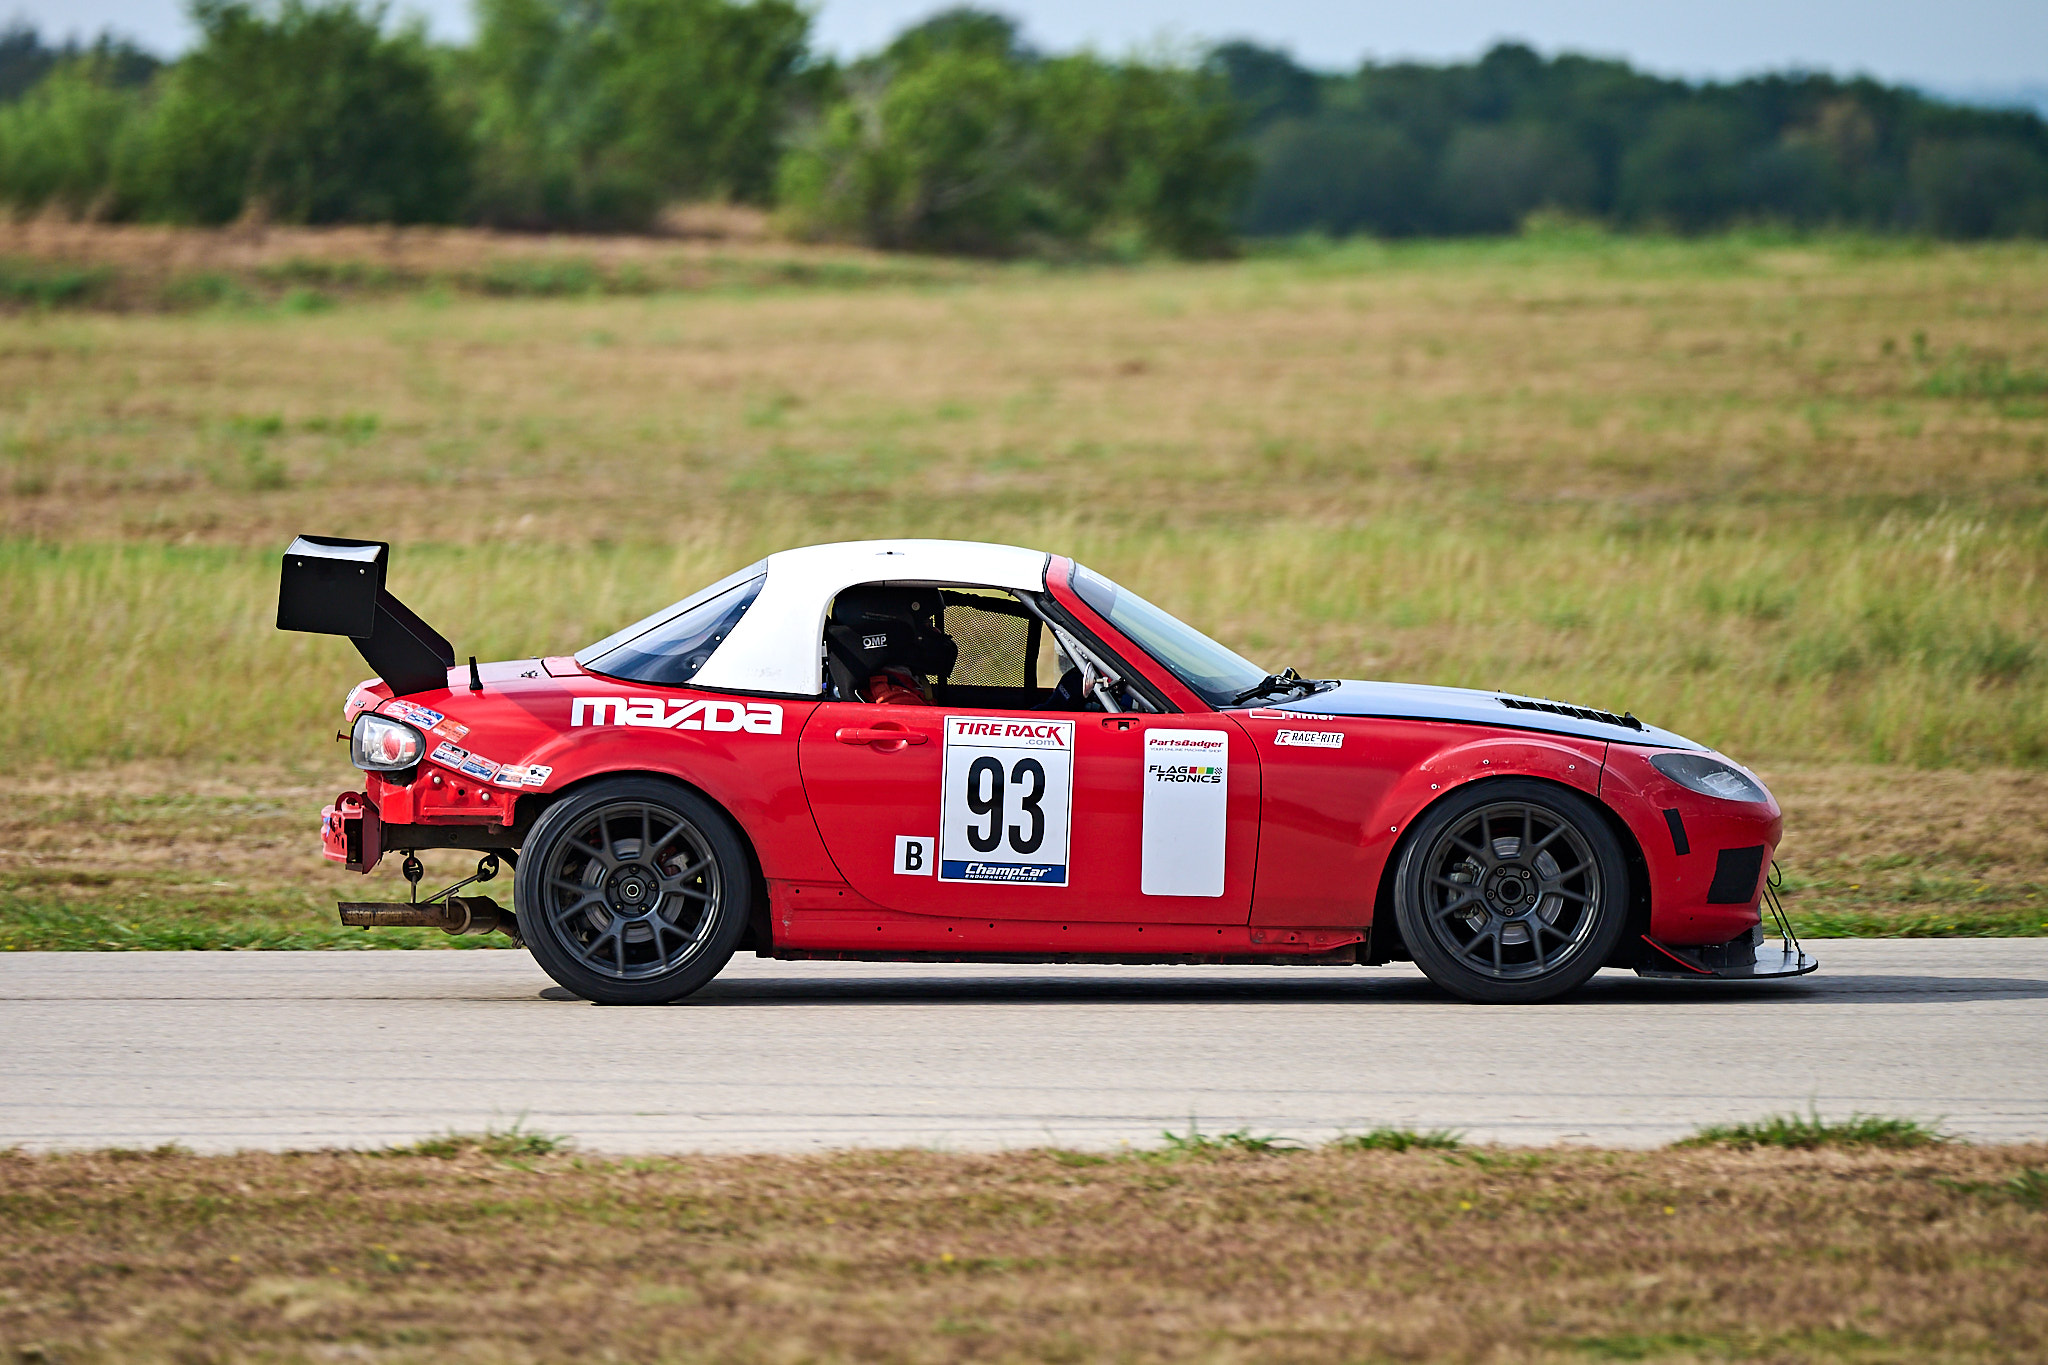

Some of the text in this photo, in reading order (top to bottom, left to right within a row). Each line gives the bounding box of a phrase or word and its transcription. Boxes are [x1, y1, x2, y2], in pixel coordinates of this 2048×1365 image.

[863, 635, 887, 648] OMP
[956, 722, 1065, 746] TIRE RACK
[1149, 739, 1224, 749] PartsBadger
[1148, 765, 1188, 774] FLAG
[1156, 774, 1222, 784] TRONICS
[967, 756, 1046, 854] 93
[905, 841, 923, 871] B
[965, 863, 1048, 879] ChampCar
